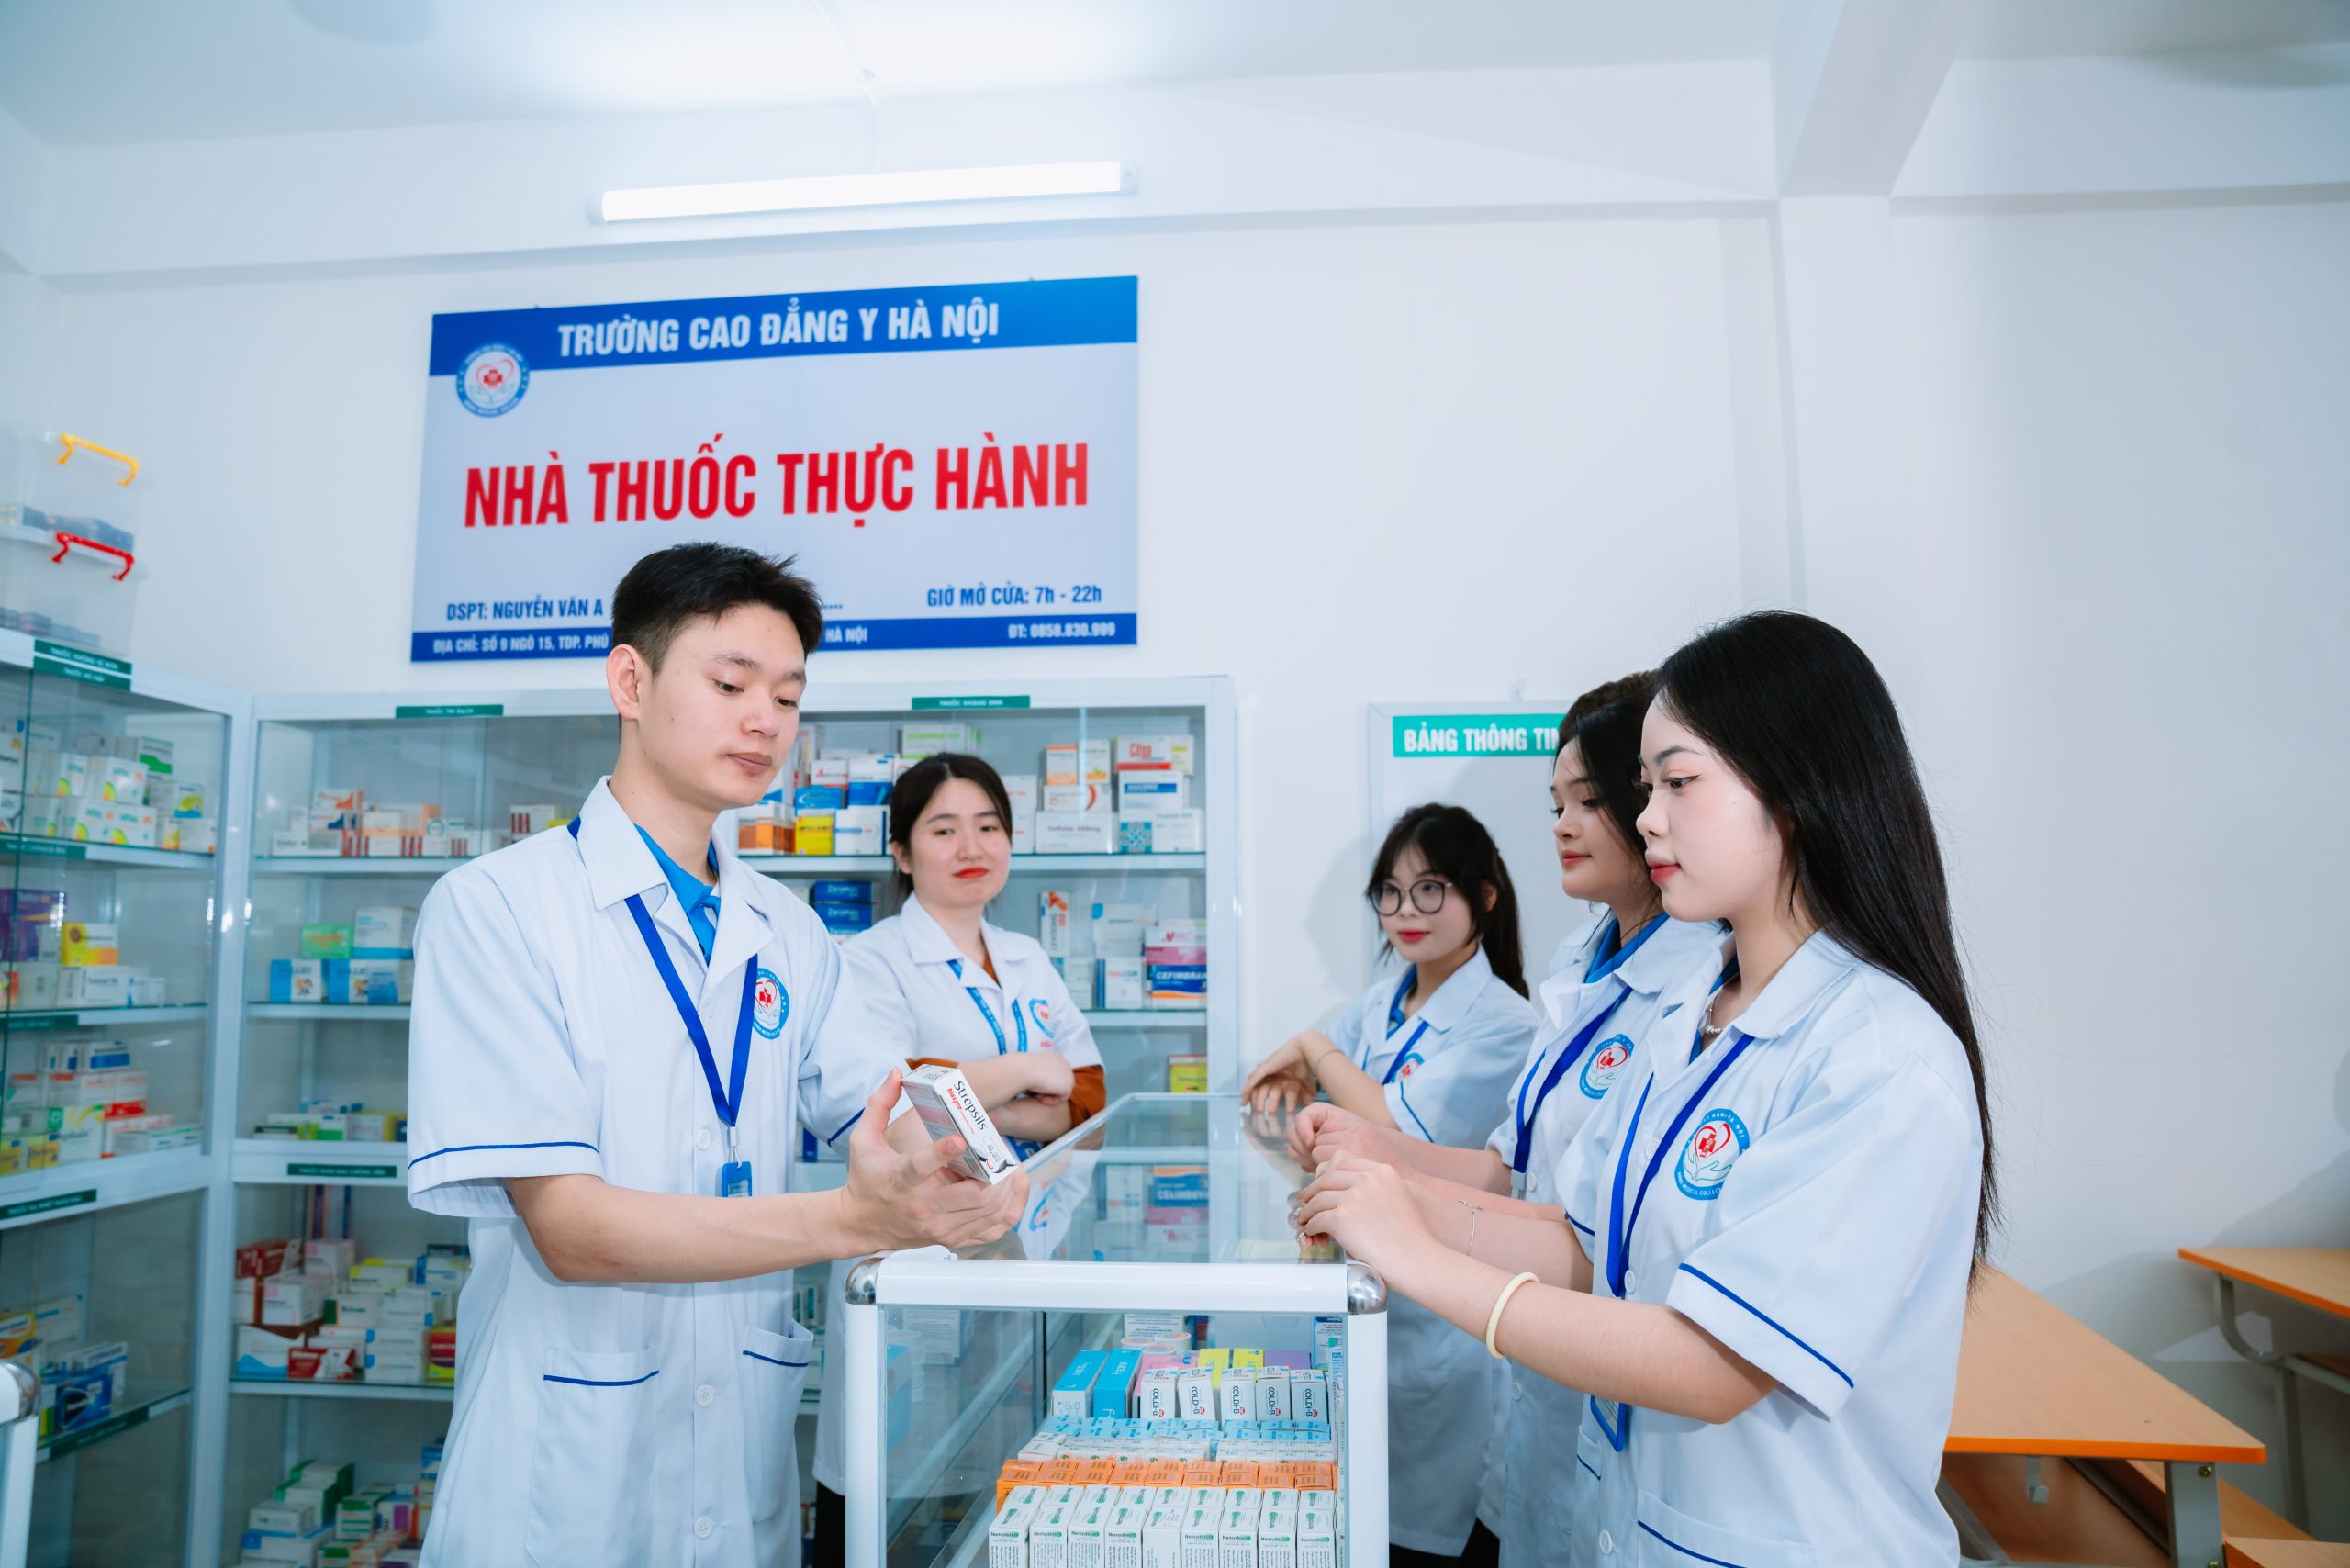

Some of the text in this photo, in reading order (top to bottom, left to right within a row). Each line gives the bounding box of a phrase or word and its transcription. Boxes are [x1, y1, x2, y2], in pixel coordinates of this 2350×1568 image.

[558, 297, 999, 357] TRƯỜNG CAO ĐẲNG Y HÀ NỘI
[464, 431, 1088, 528] NHÀ THUỐC THỰC HÀNH
[446, 593, 603, 621] DSPT: NGUYỄN VĂN A
[927, 584, 955, 607] GIỜ
[959, 581, 987, 606] MỞ
[991, 580, 1029, 605] CỬA:
[1035, 586, 1055, 604] 7h
[1071, 585, 1102, 603] 22h
[845, 623, 868, 645] NỘI
[1404, 722, 1459, 752] BẢNG
[1463, 723, 1528, 752] THÔNG
[946, 1087, 963, 1111] Maxpro
[953, 1081, 987, 1130] Strepsils
